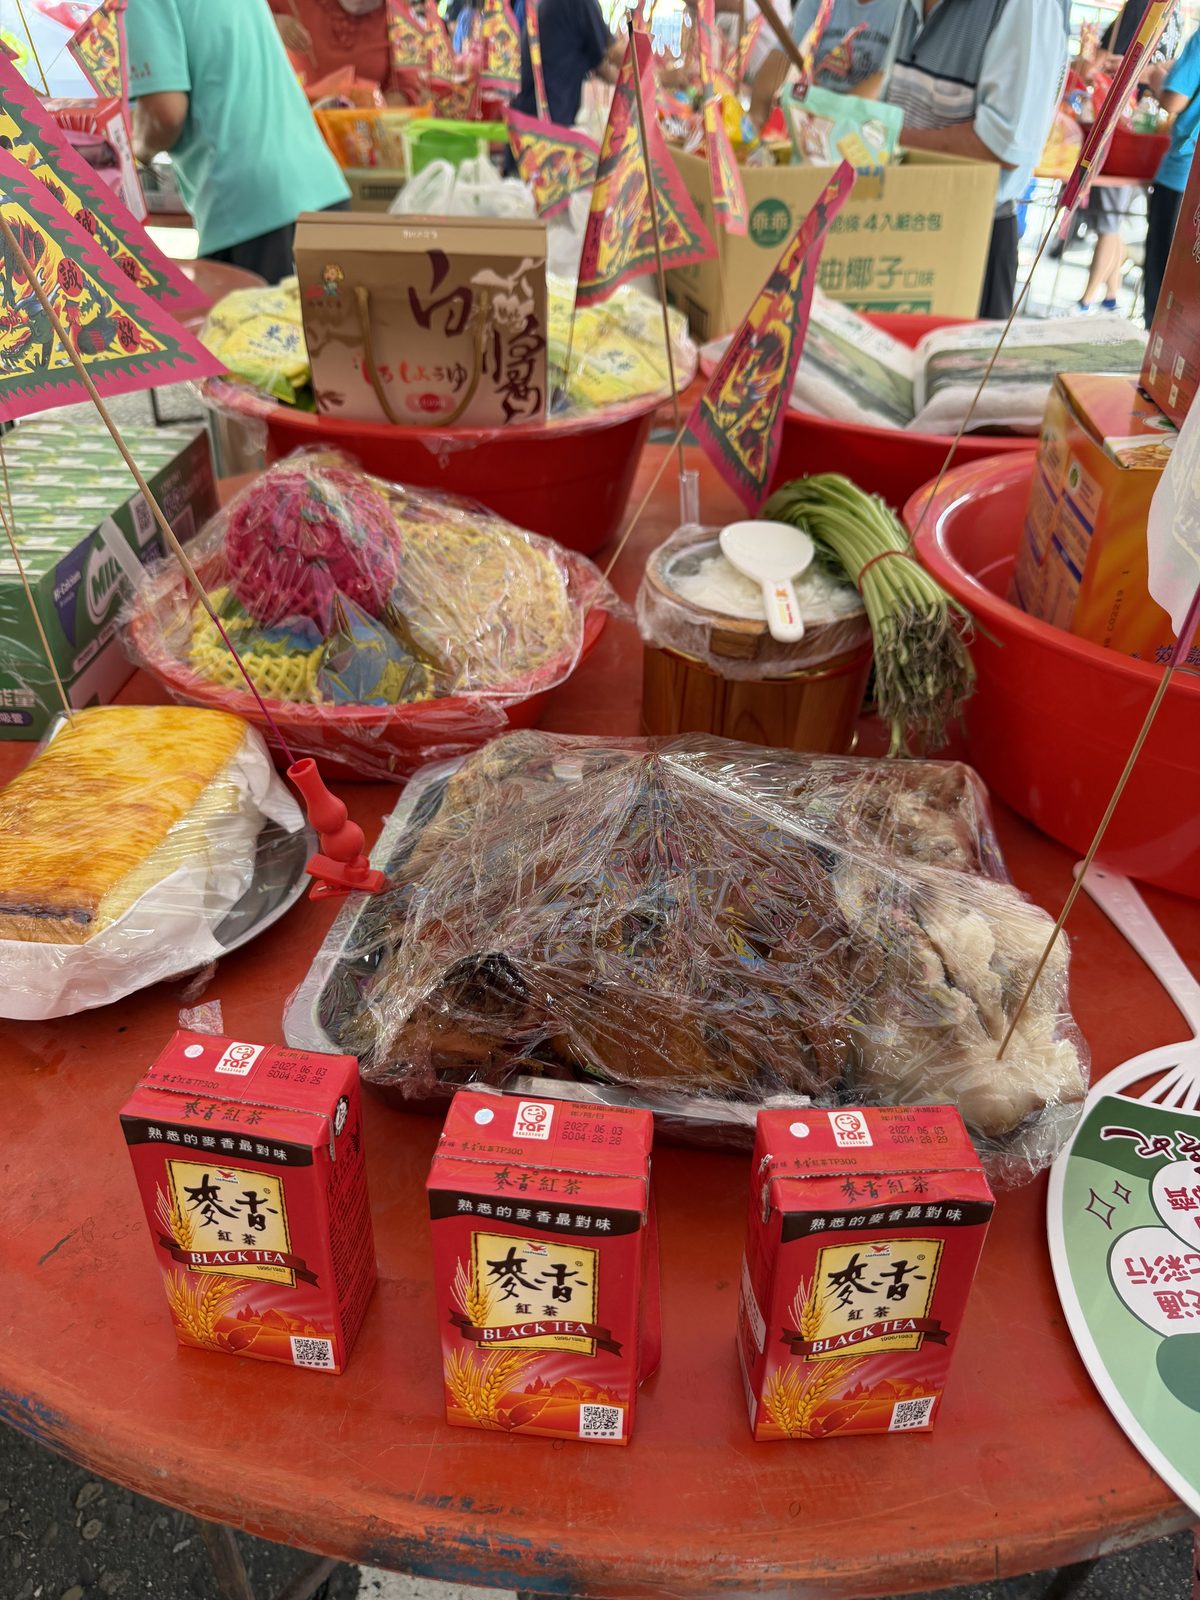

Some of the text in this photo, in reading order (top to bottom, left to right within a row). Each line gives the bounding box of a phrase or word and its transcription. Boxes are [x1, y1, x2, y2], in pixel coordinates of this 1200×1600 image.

[60, 258, 83, 292] 誠
[223, 1058, 250, 1070] TQF
[516, 1122, 546, 1133] TQF
[837, 1131, 866, 1141] TQF
[147, 1126, 288, 1161] 熟悉的麥香最對味
[183, 1173, 279, 1232] 麥香
[456, 1198, 612, 1231] 熟悉的麥香最對味
[809, 1206, 963, 1232] 熟悉的麥香最對味
[217, 1229, 257, 1246] 紅茶
[191, 1250, 286, 1264] BLACK TEA
[486, 1246, 589, 1303] 麥香
[823, 1253, 927, 1312] 麥香
[515, 1303, 559, 1317] 紅茶
[847, 1306, 891, 1322] 紅茶
[483, 1321, 588, 1340] BLACK TEA
[812, 1319, 917, 1353] BLACK TEA
